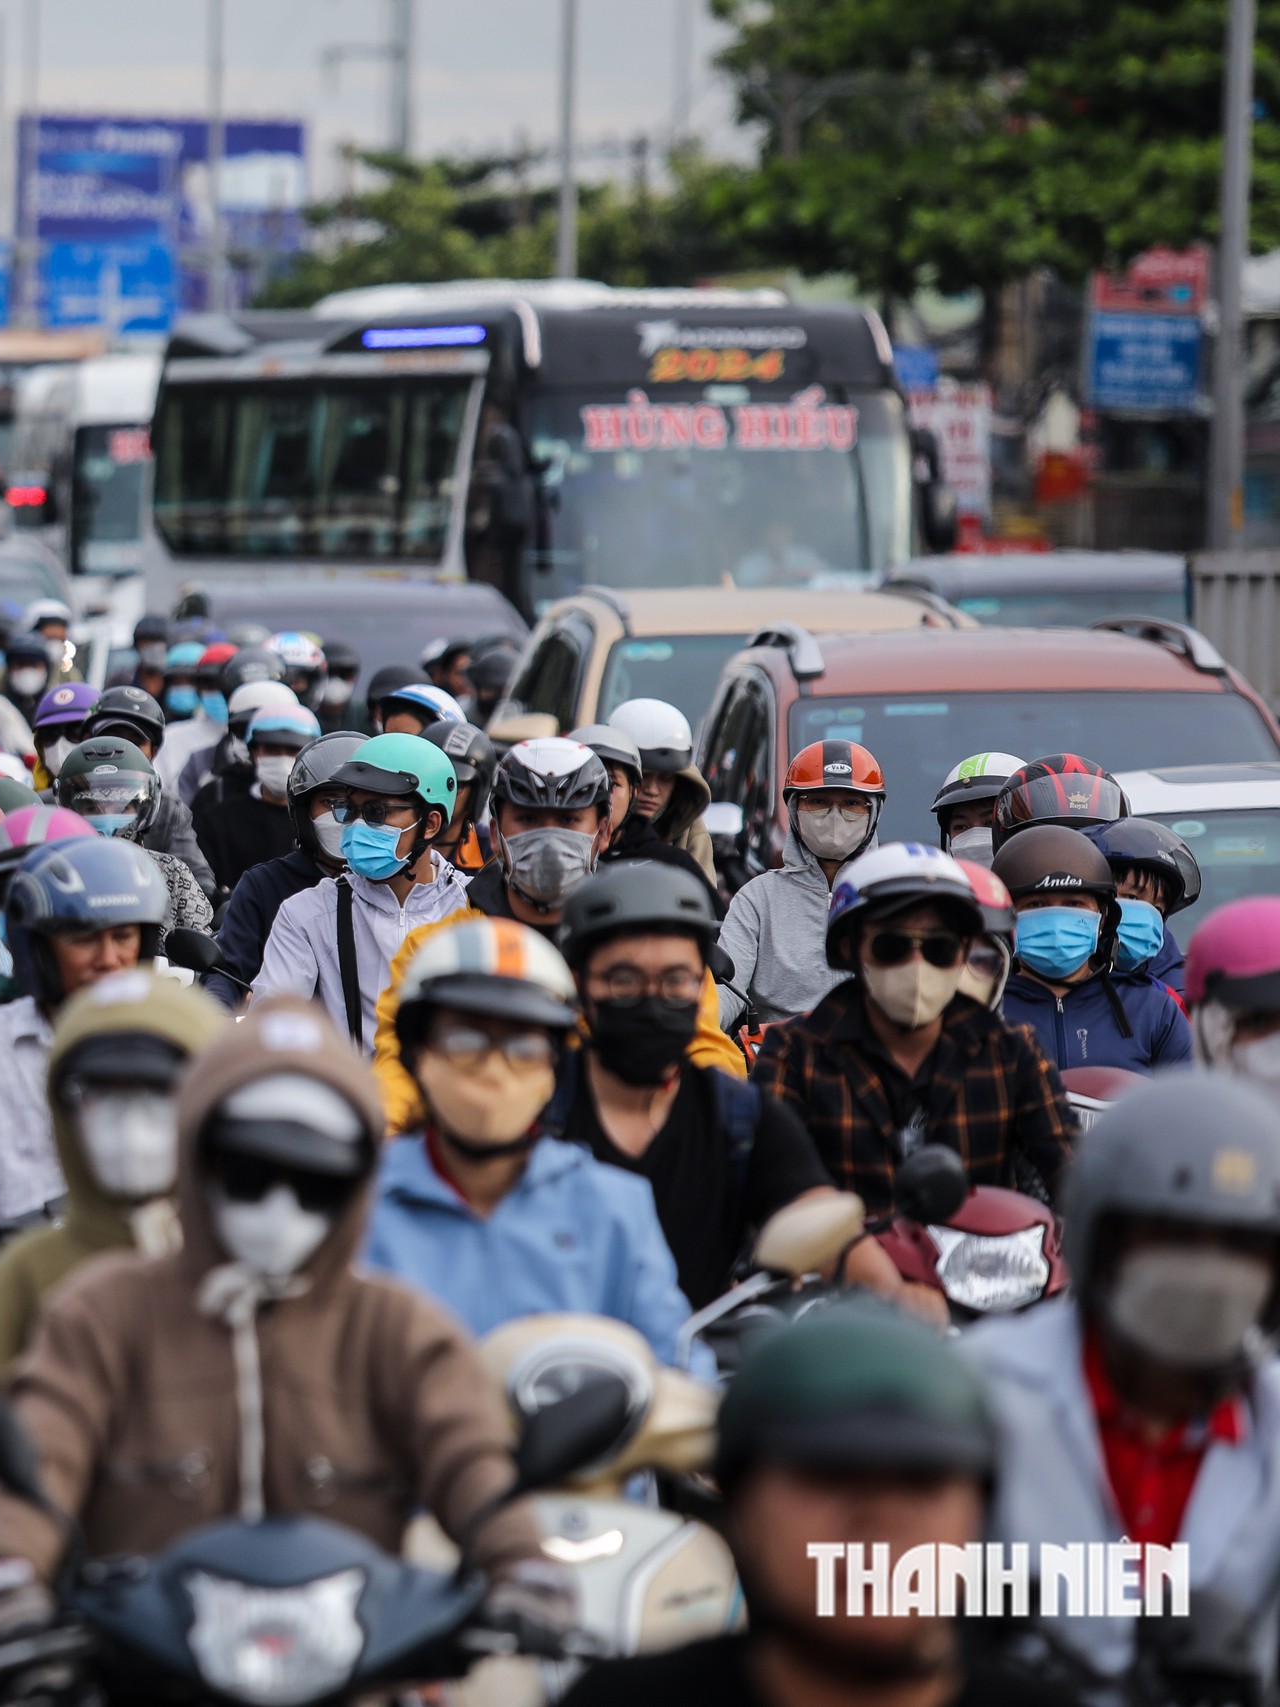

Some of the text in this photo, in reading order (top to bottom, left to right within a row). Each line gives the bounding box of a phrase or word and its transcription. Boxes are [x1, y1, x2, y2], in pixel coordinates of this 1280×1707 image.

[649, 347, 785, 383] 2024
[580, 387, 728, 451] HÙNG
[1035, 874, 1083, 889] Andes
[86, 894, 140, 908] HONDA
